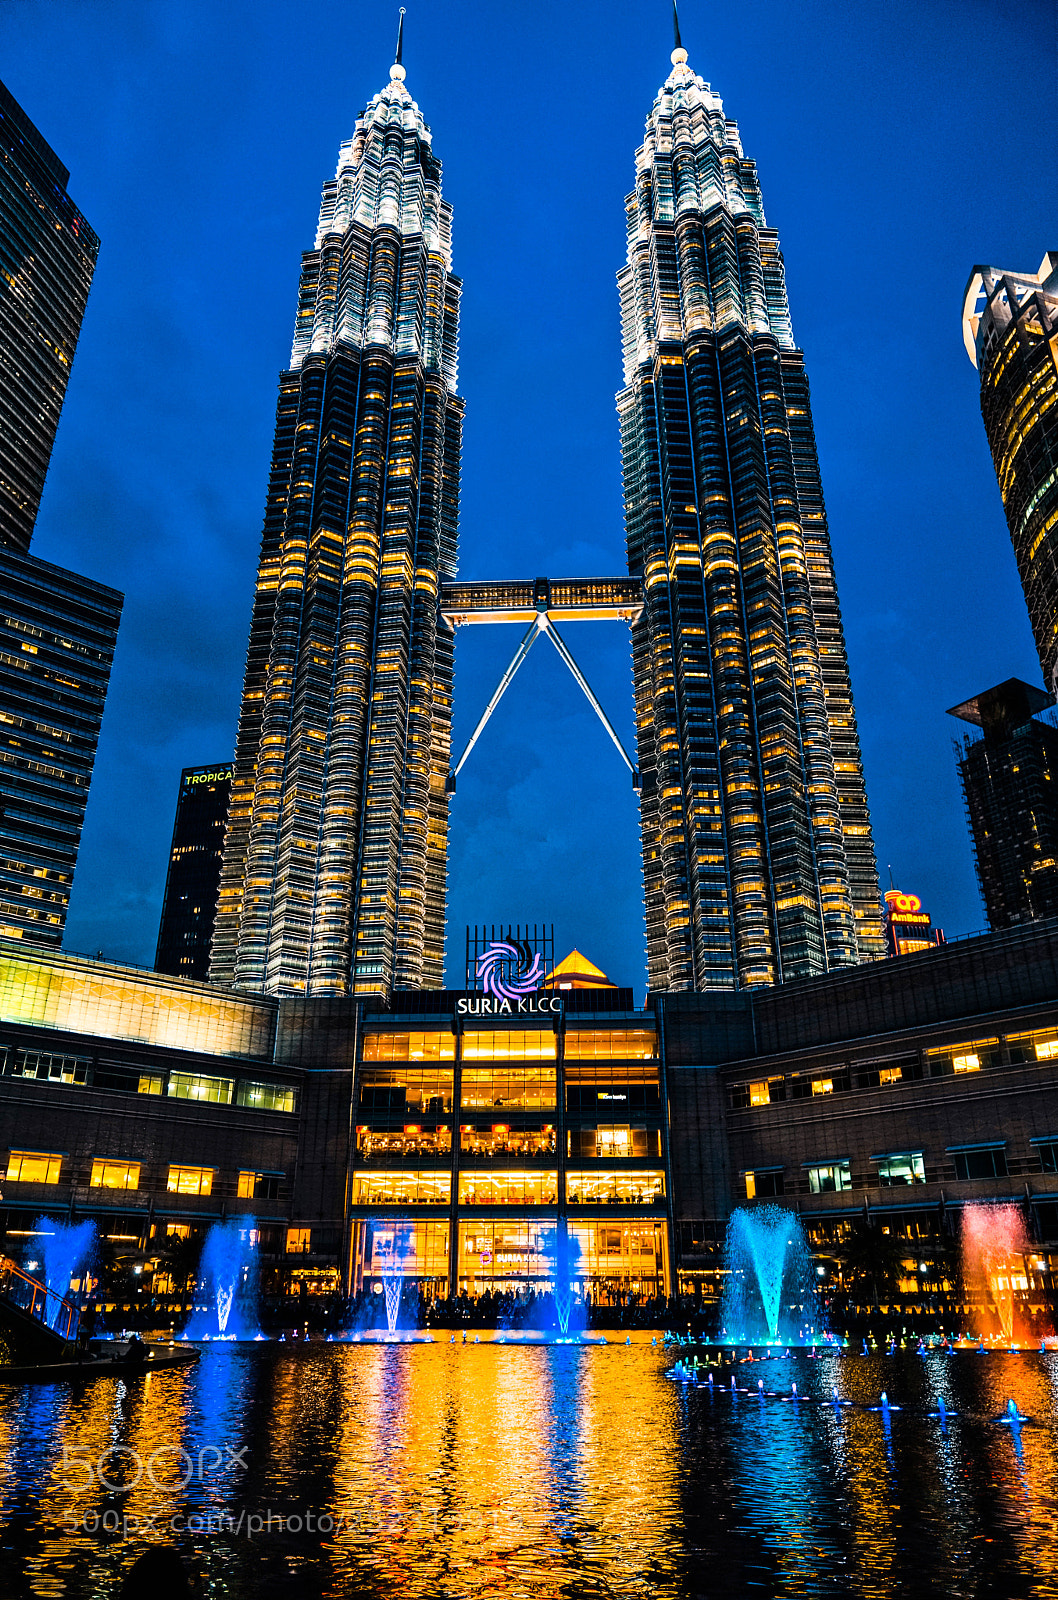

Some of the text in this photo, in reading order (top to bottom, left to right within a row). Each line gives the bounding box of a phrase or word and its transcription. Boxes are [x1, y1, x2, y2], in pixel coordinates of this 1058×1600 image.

[186, 771, 233, 785] TROPICA
[891, 912, 930, 923] AmBank
[457, 997, 561, 1014] SURIA KLCC
[497, 1254, 543, 1263] SURIA KLCC
